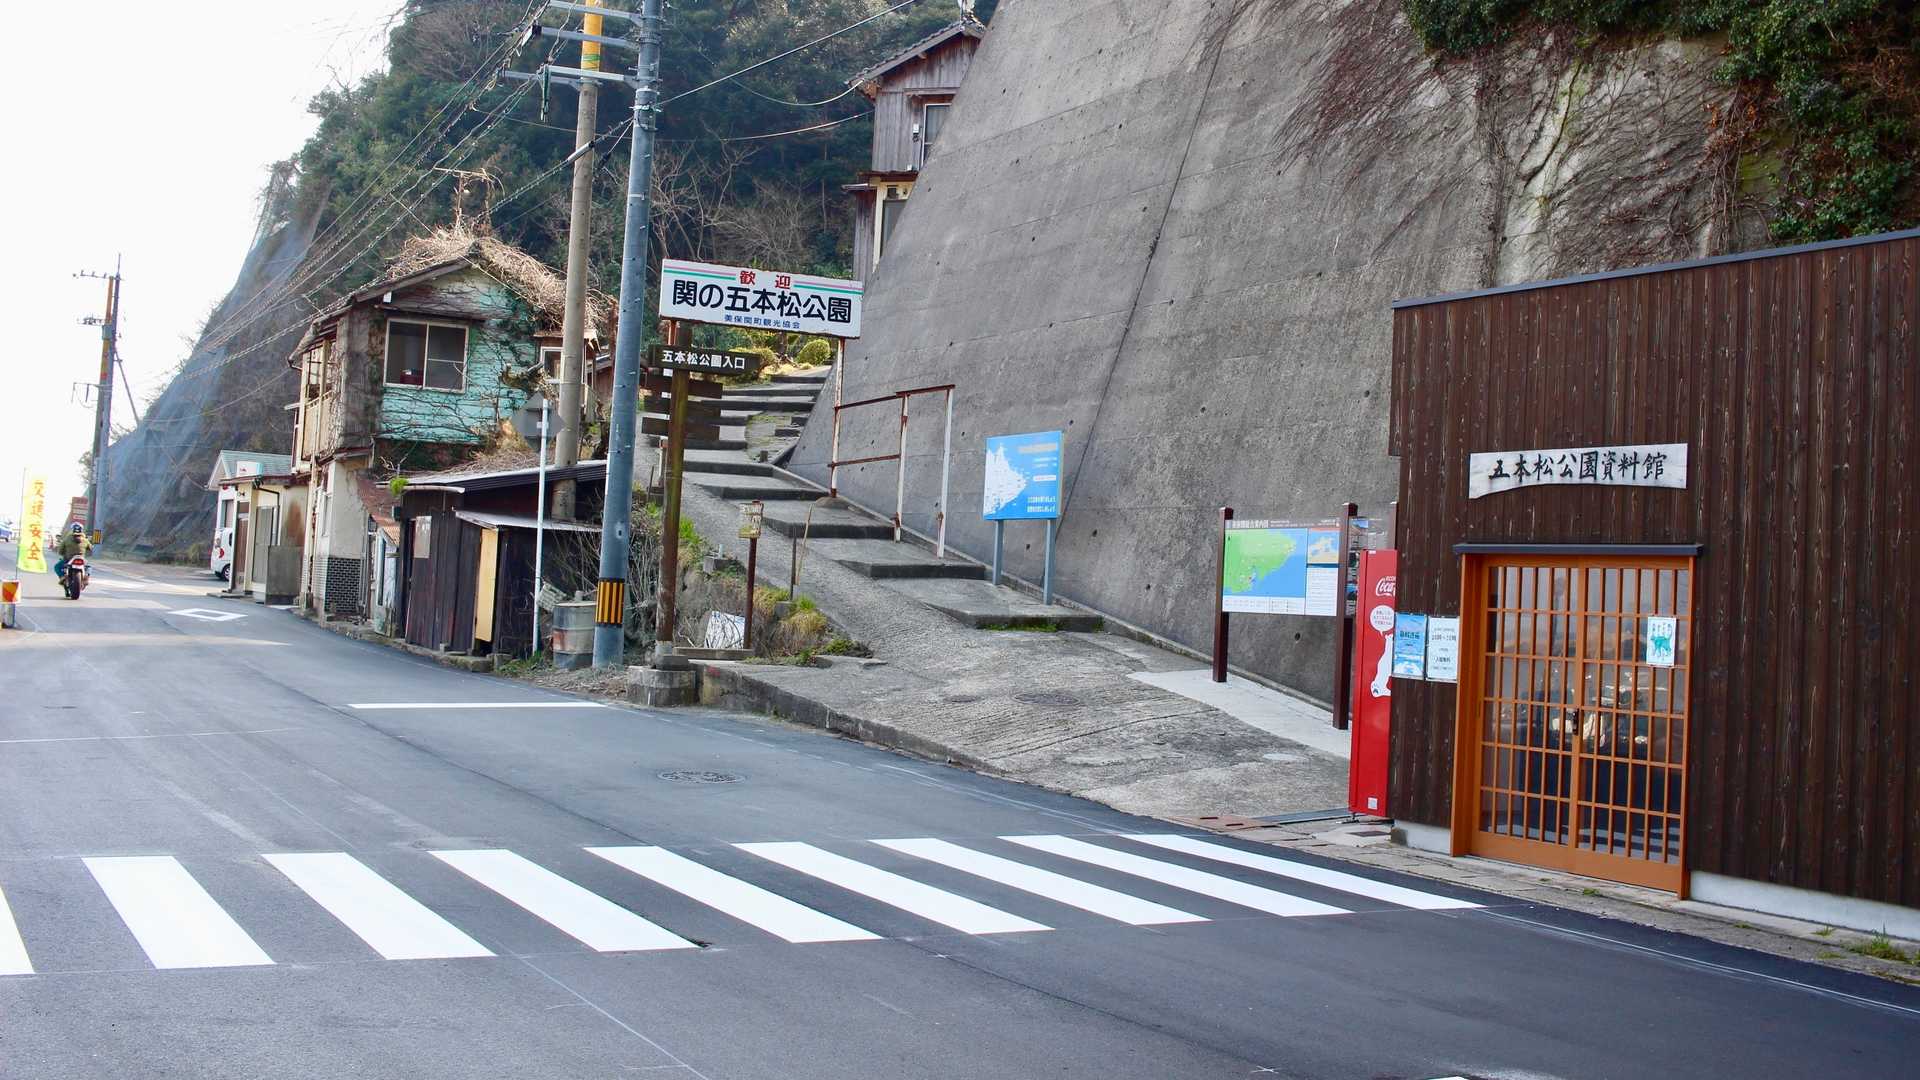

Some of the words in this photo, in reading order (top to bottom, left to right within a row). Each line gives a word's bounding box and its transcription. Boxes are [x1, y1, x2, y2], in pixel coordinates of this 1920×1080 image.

[673, 280, 851, 323] 関の五本松公園
[724, 315, 800, 329] 美保関町観光協会
[662, 350, 745, 370] 五本松公園入口
[1488, 450, 1668, 483] 五本松公園資料館
